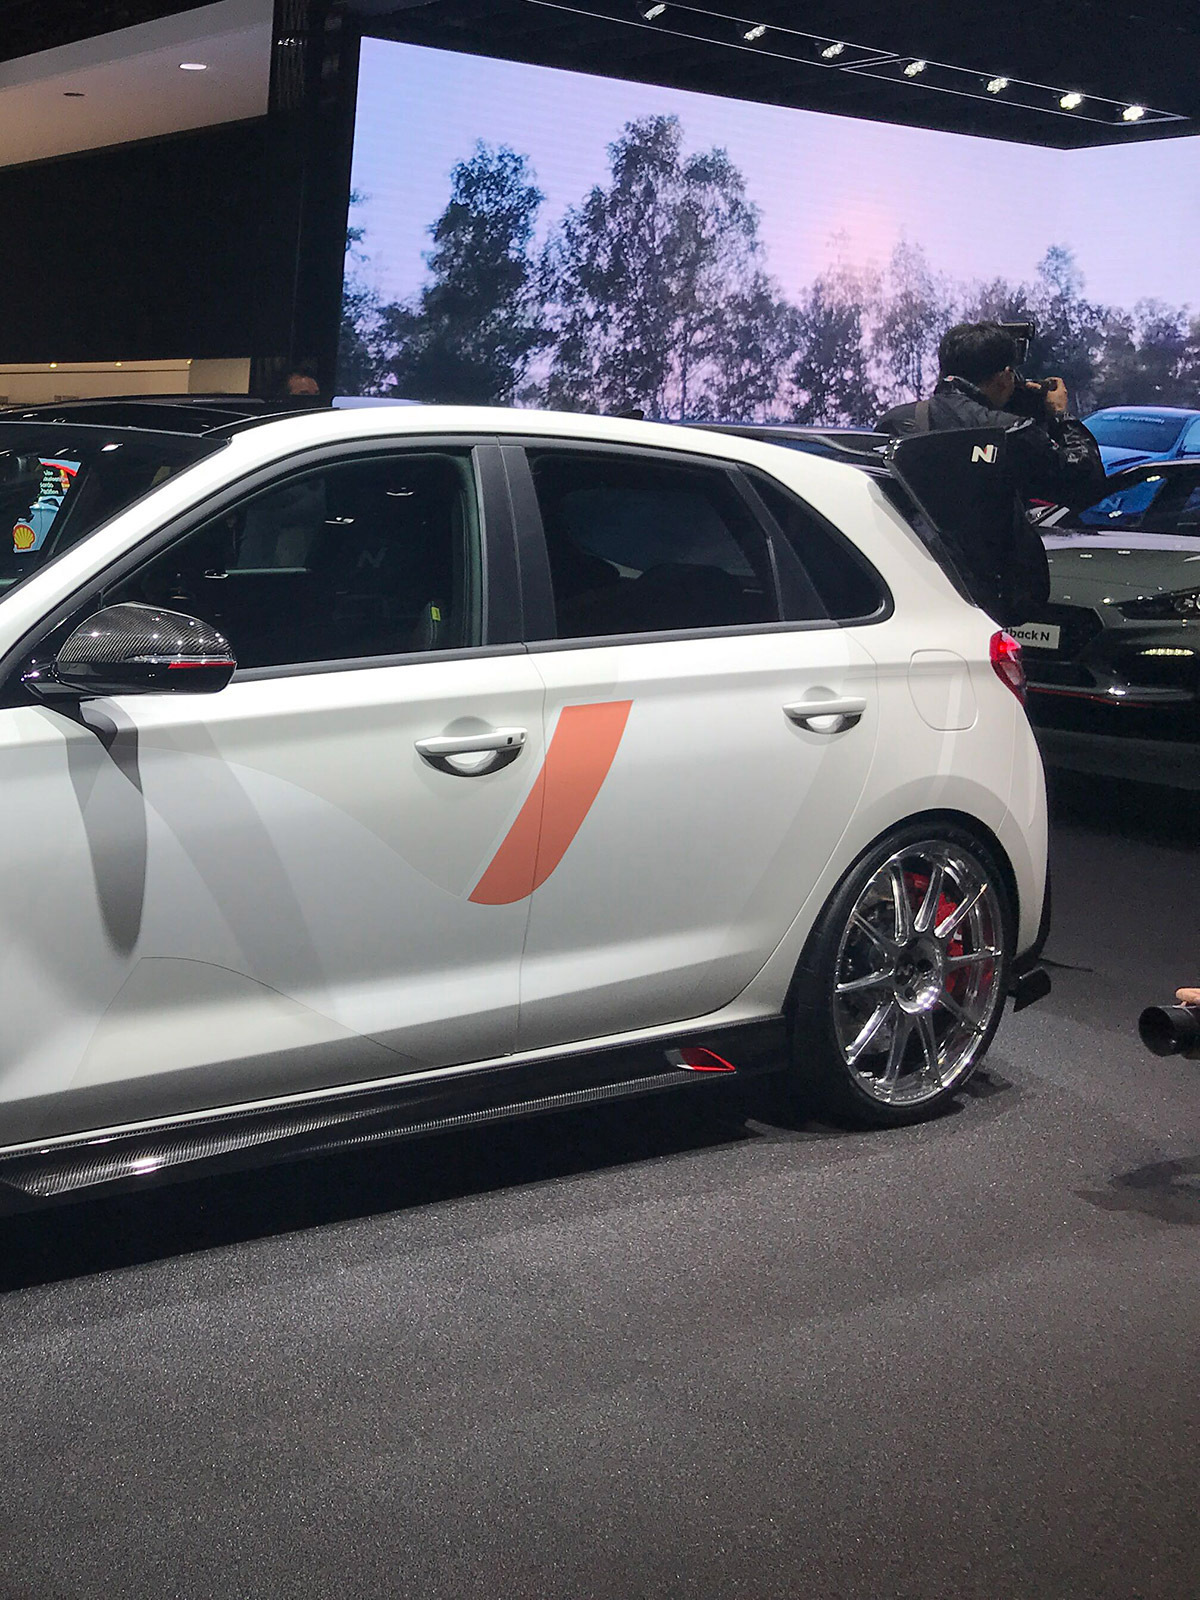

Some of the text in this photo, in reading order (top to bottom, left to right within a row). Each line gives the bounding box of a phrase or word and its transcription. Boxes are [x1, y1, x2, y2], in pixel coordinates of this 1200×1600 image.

[971, 444, 998, 463] N
[1006, 629, 1050, 641] back N
